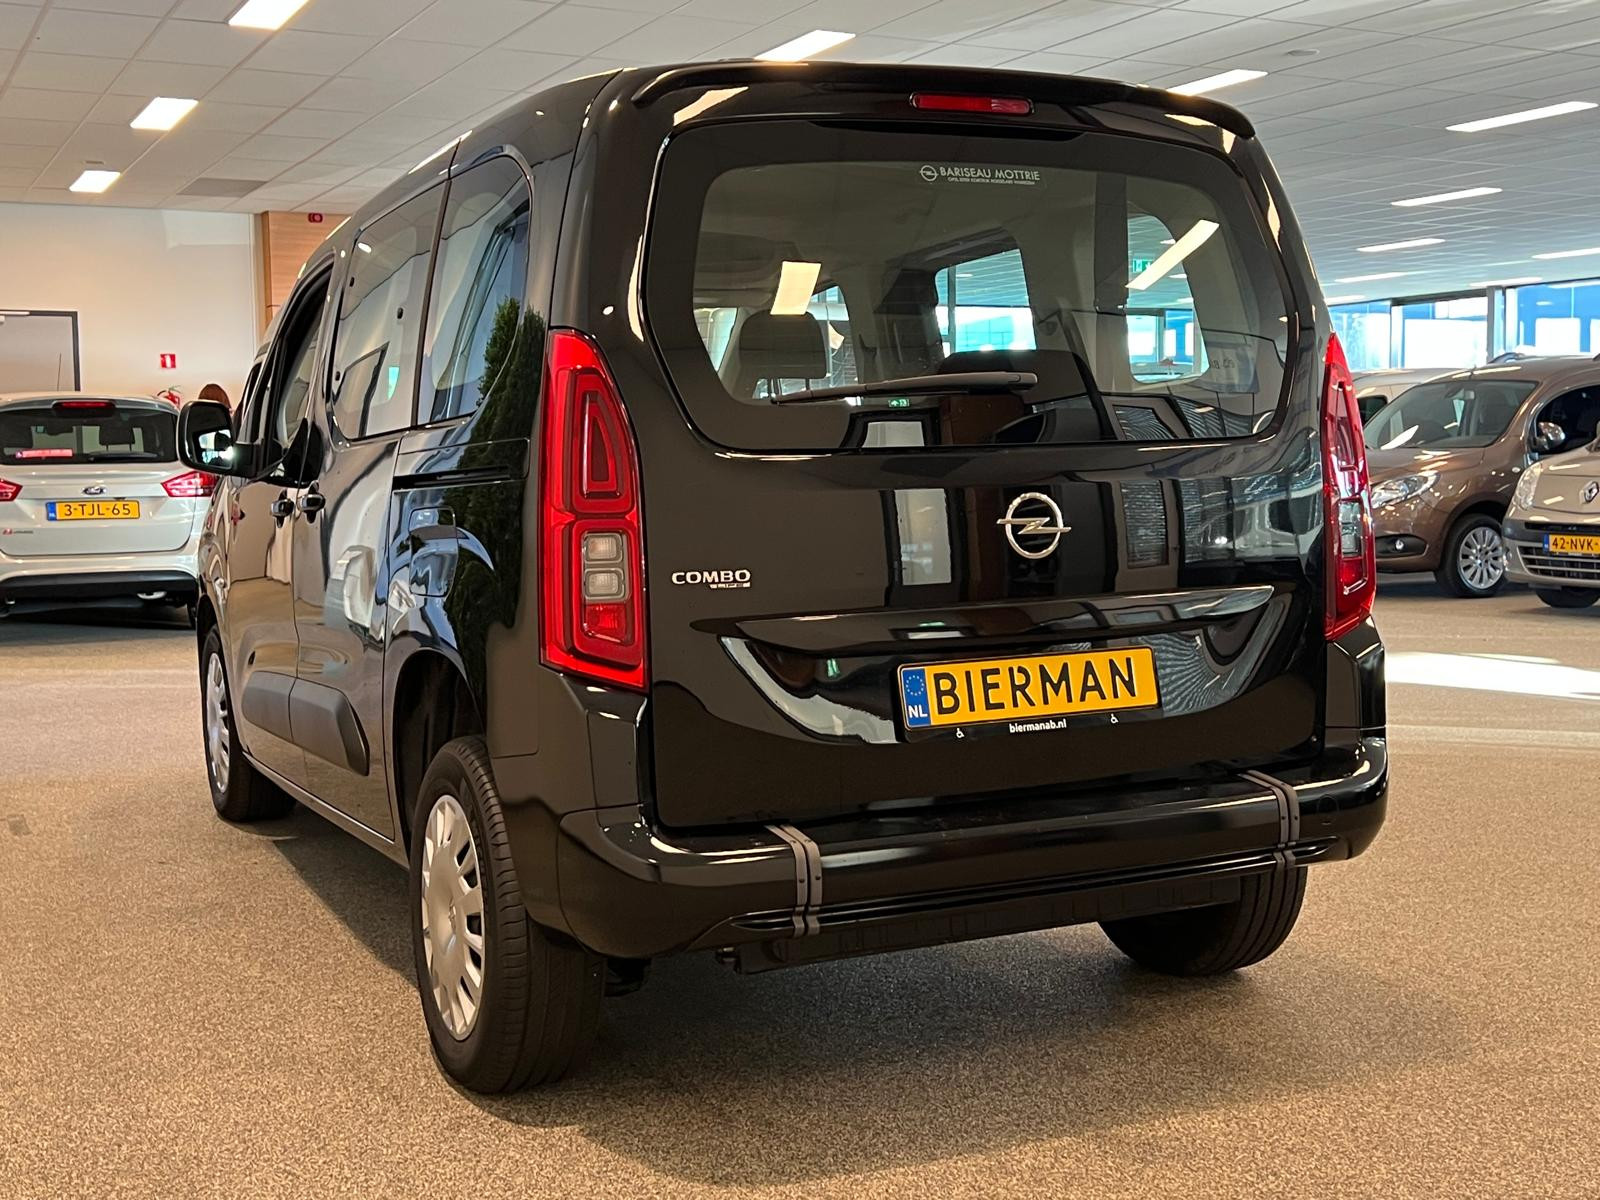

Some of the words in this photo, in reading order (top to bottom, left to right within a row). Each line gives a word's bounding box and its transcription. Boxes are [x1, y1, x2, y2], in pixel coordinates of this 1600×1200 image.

[940, 166, 991, 178] BARISEAU
[995, 169, 1040, 181] MOTTRIE
[64, 503, 131, 516] 3-TJL-65
[671, 569, 751, 585] COMBO
[908, 705, 928, 718] NL
[933, 657, 1137, 715] BIERMAN
[1009, 719, 1068, 734] biermanab.nl
